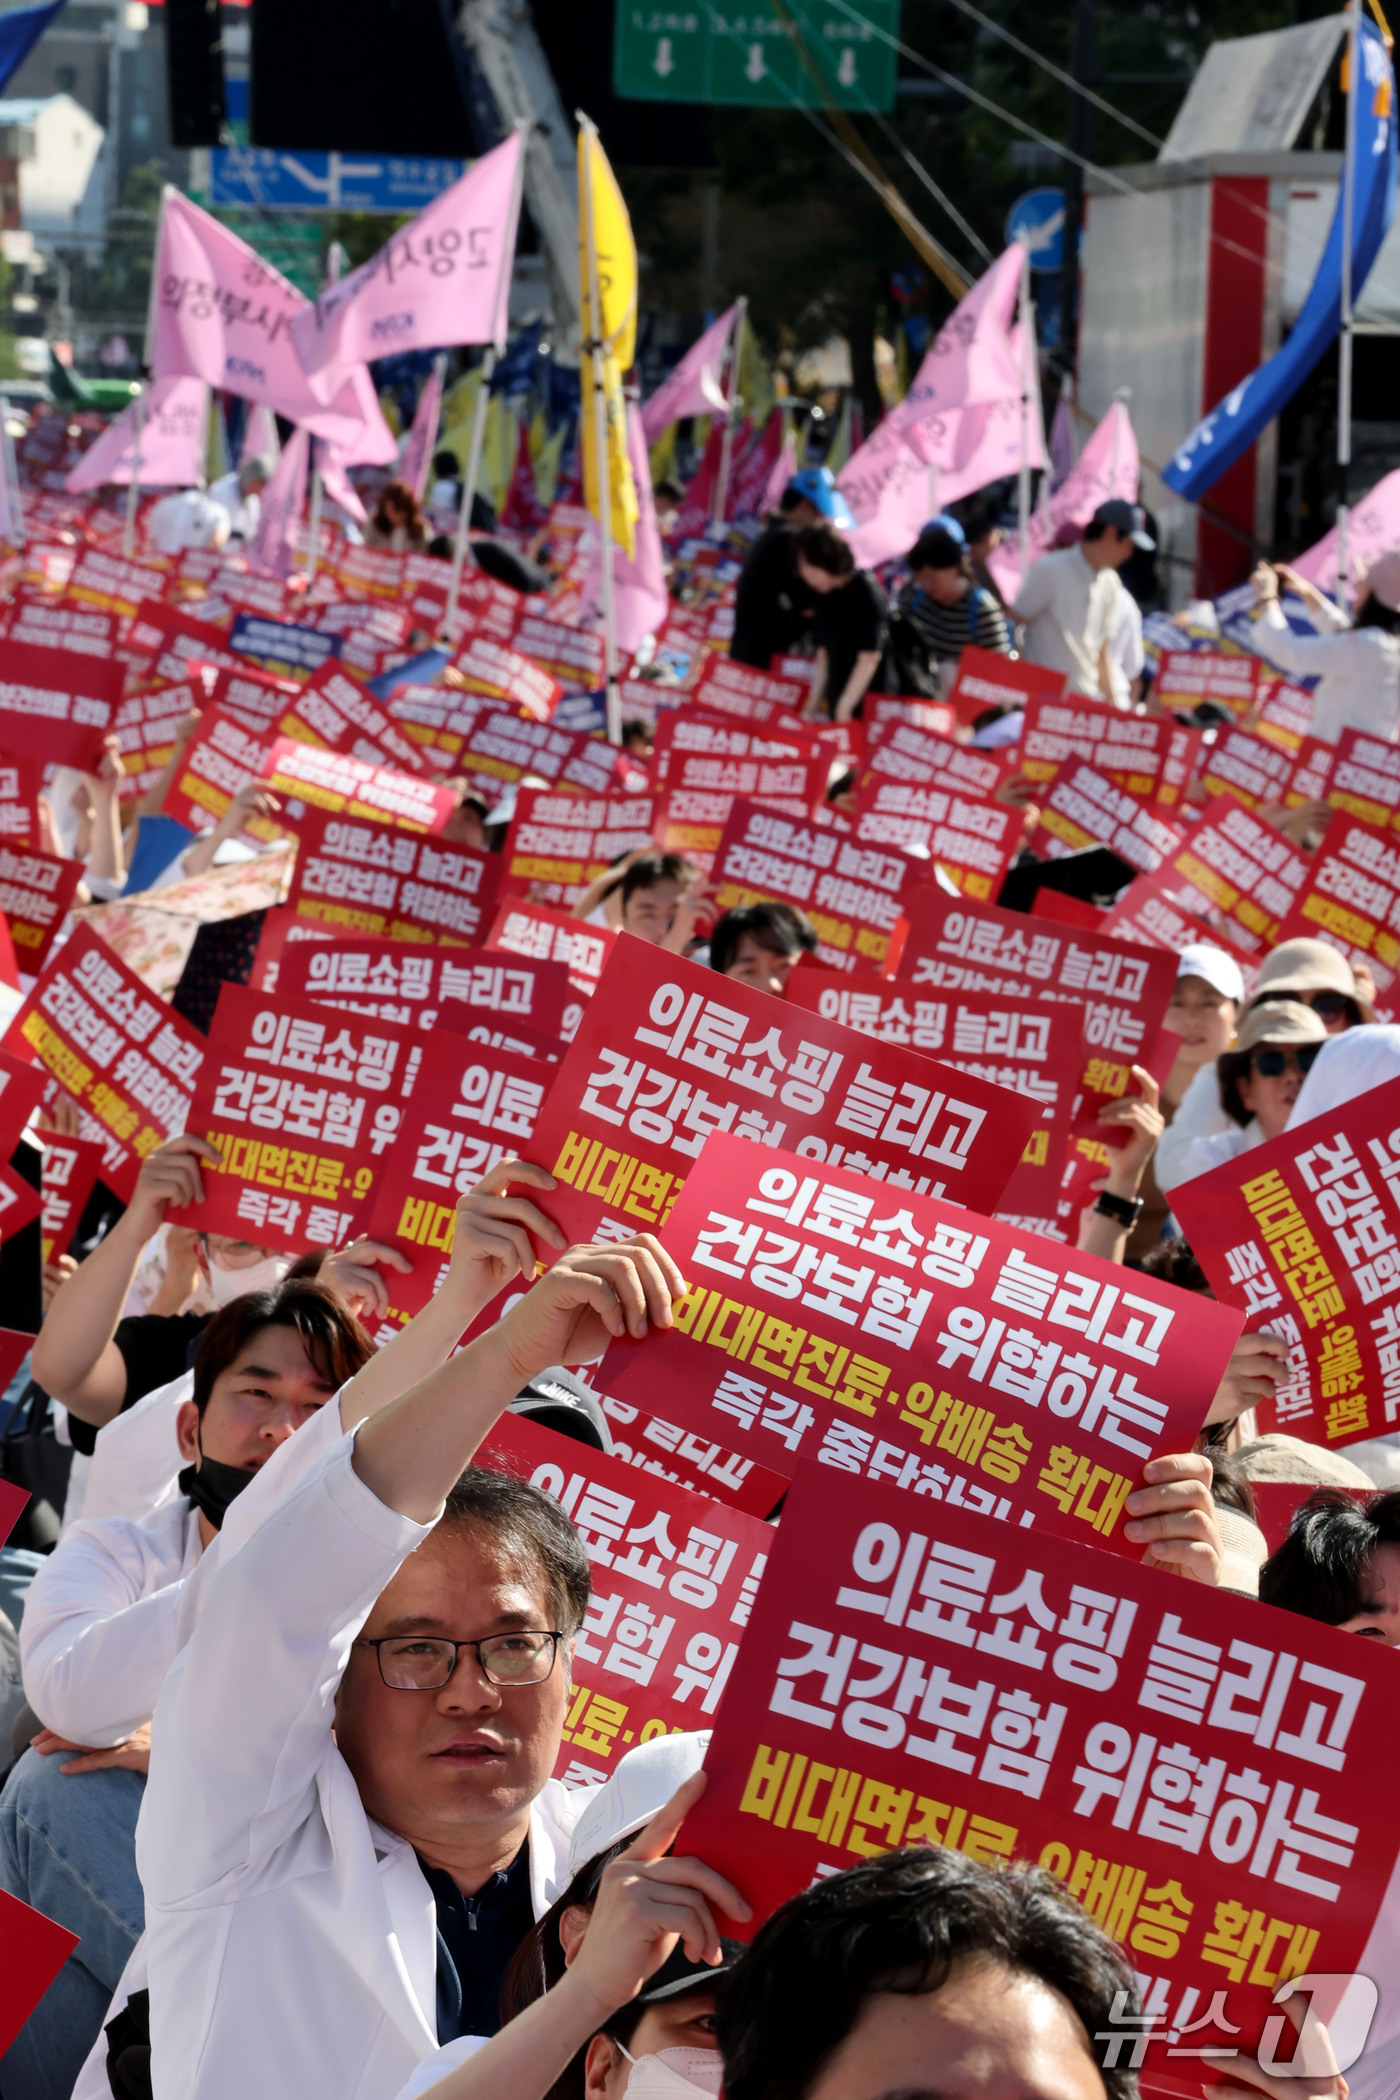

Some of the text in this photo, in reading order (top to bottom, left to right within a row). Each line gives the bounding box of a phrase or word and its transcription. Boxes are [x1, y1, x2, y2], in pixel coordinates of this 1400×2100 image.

[301, 856, 399, 909] 건강보험
[320, 821, 485, 895] 의료쇼핑 늘리고
[72, 949, 163, 1043] 의료쇼핑
[305, 952, 434, 1001] 의료쇼핑
[438, 961, 536, 1015] 늘리고
[936, 911, 1062, 981] 의료쇼핑
[1059, 942, 1151, 1003] 늘리고
[40, 971, 127, 1070] 건강보험
[243, 1010, 400, 1092] 의료쇼핑
[952, 1005, 1052, 1062] 늘리고
[212, 1065, 367, 1149] 건강보험
[633, 982, 845, 1117] 의료쇼핑
[835, 1062, 989, 1172] 늘리고
[236, 1187, 302, 1236] 즉각
[745, 1167, 991, 1290] 의료쇼핑
[990, 1247, 1176, 1367] 늘리고
[1224, 1240, 1284, 1317] 즉각
[1239, 1168, 1370, 1440] 비대면진료·약배송 확대
[690, 1209, 1169, 1461] 건강보험 위협하는
[671, 1280, 1034, 1486] 비대면진료·약배송
[1036, 1443, 1135, 1538] 확대
[711, 1369, 816, 1453] 즉각
[528, 1461, 740, 1611] 의료쇼핑
[836, 1520, 1139, 1694] 의료쇼핑
[1137, 1611, 1367, 1773] 늘리고
[768, 1620, 1069, 1802] 건강보험
[1071, 1720, 1360, 1903] 위협하는
[1200, 1898, 1321, 1990] 확대
